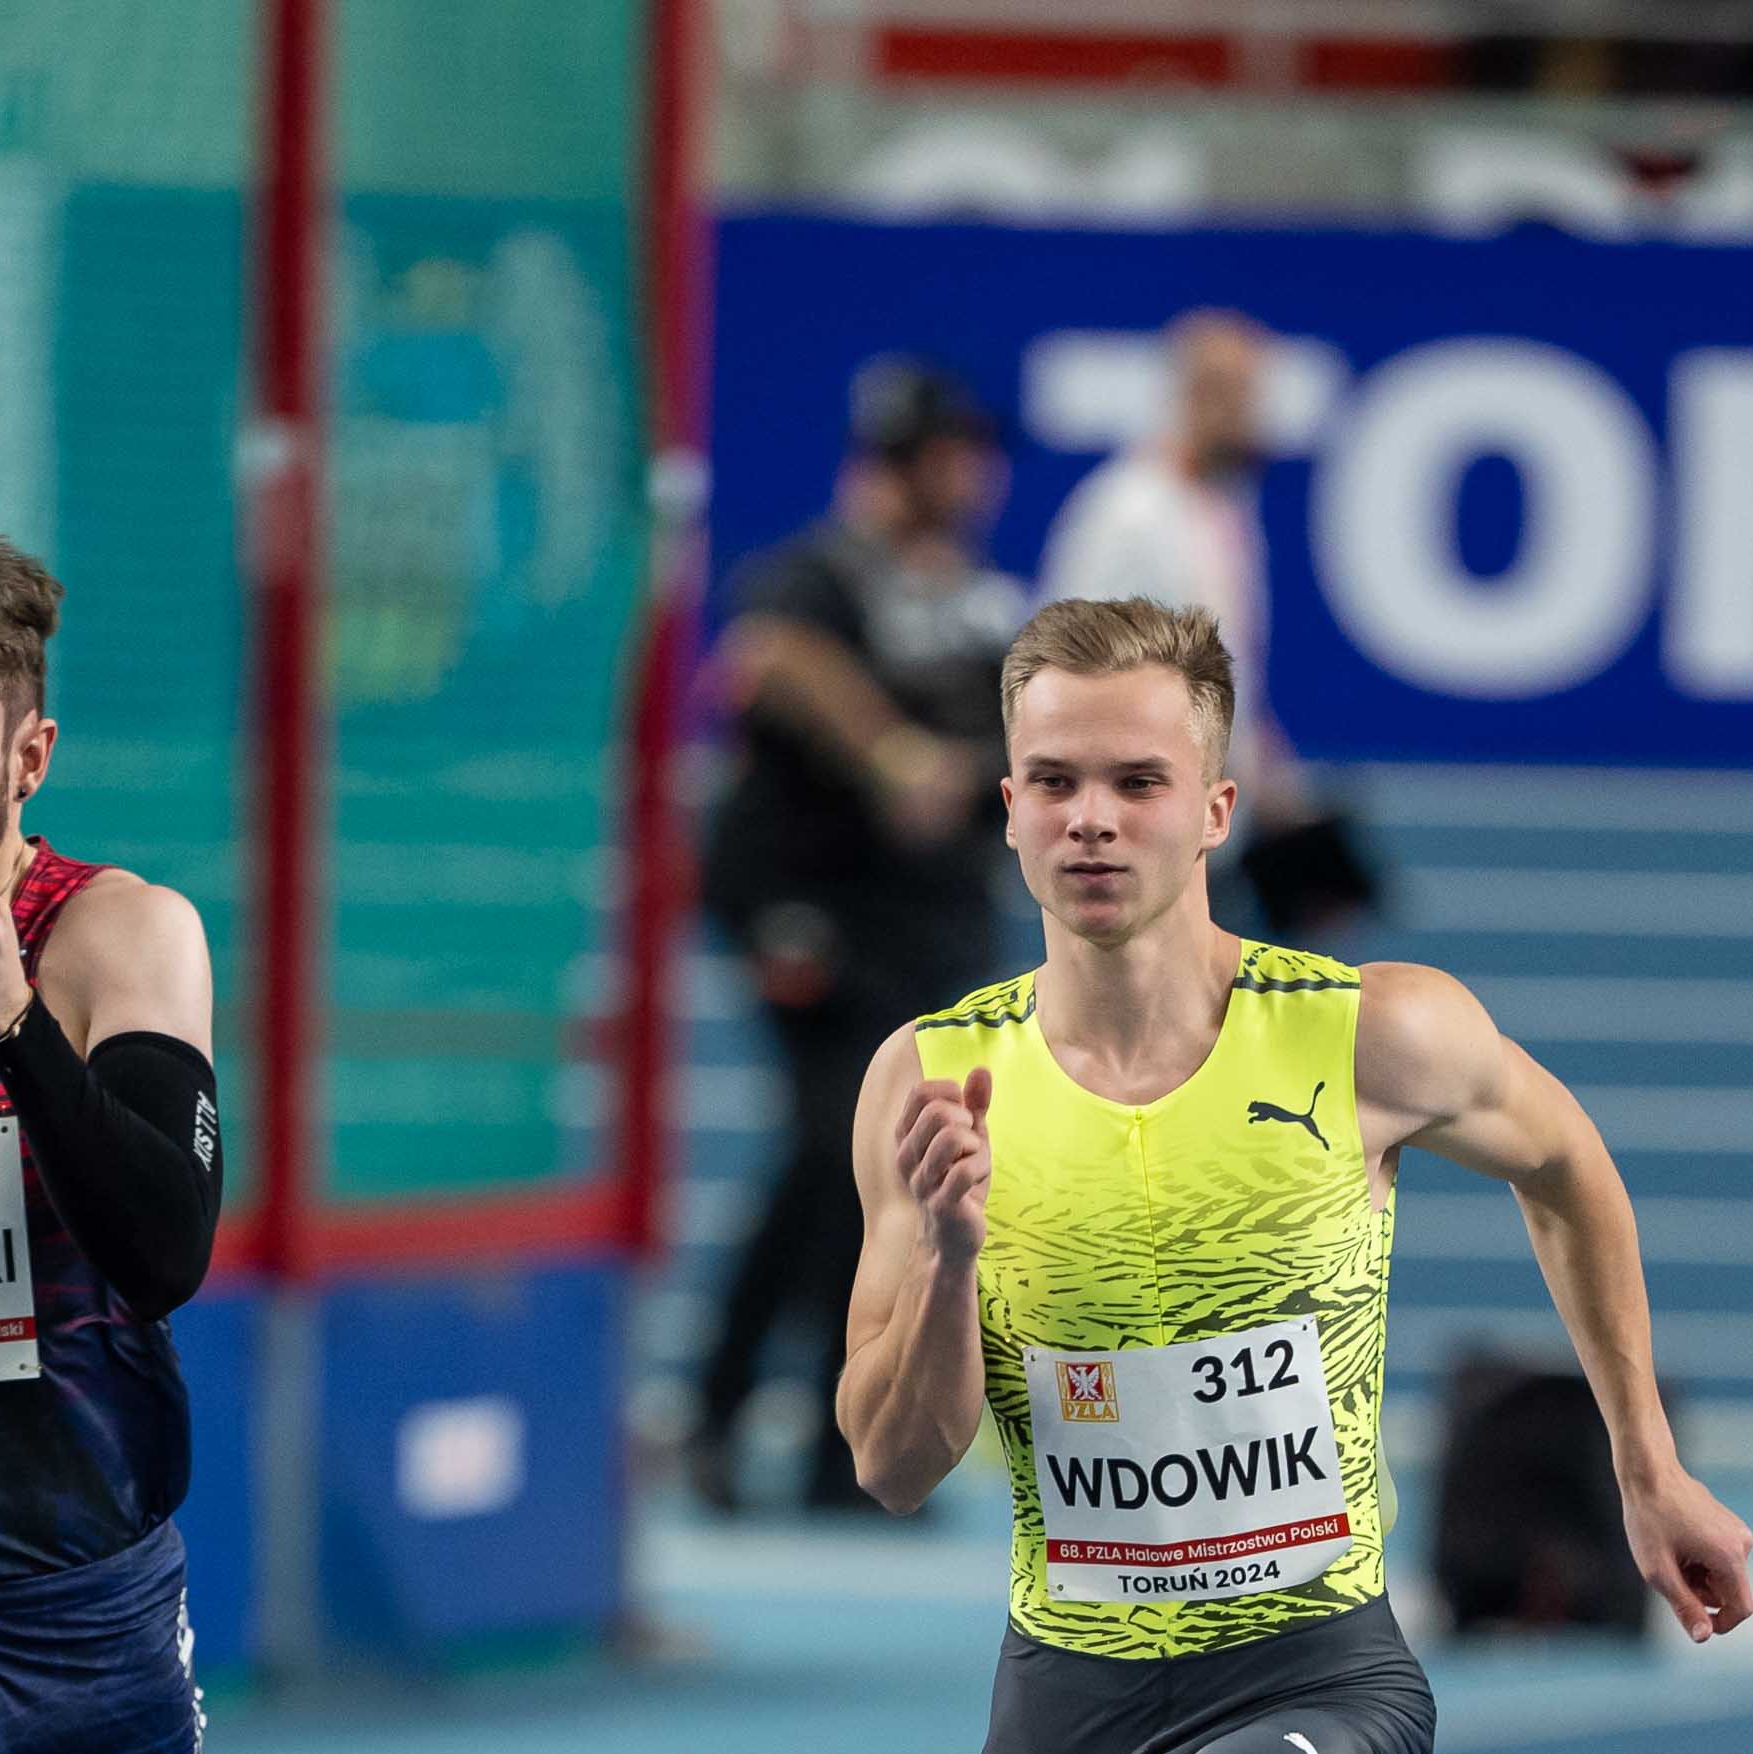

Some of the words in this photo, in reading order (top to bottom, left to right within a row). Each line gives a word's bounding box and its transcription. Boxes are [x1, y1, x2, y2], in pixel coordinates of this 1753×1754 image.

[1192, 1339, 1299, 1403] 312
[1063, 1401, 1116, 1419] PZLA
[1046, 1426, 1327, 1510] WDOWIK
[1059, 1543, 1083, 1558] 68.
[1087, 1546, 1121, 1561] PZLA
[1125, 1547, 1184, 1562] Halowe
[1187, 1530, 1287, 1559] Mistrzostwa
[1290, 1518, 1339, 1541] Polski
[1118, 1566, 1208, 1593] TORUŃ
[1214, 1560, 1280, 1588] 2024
